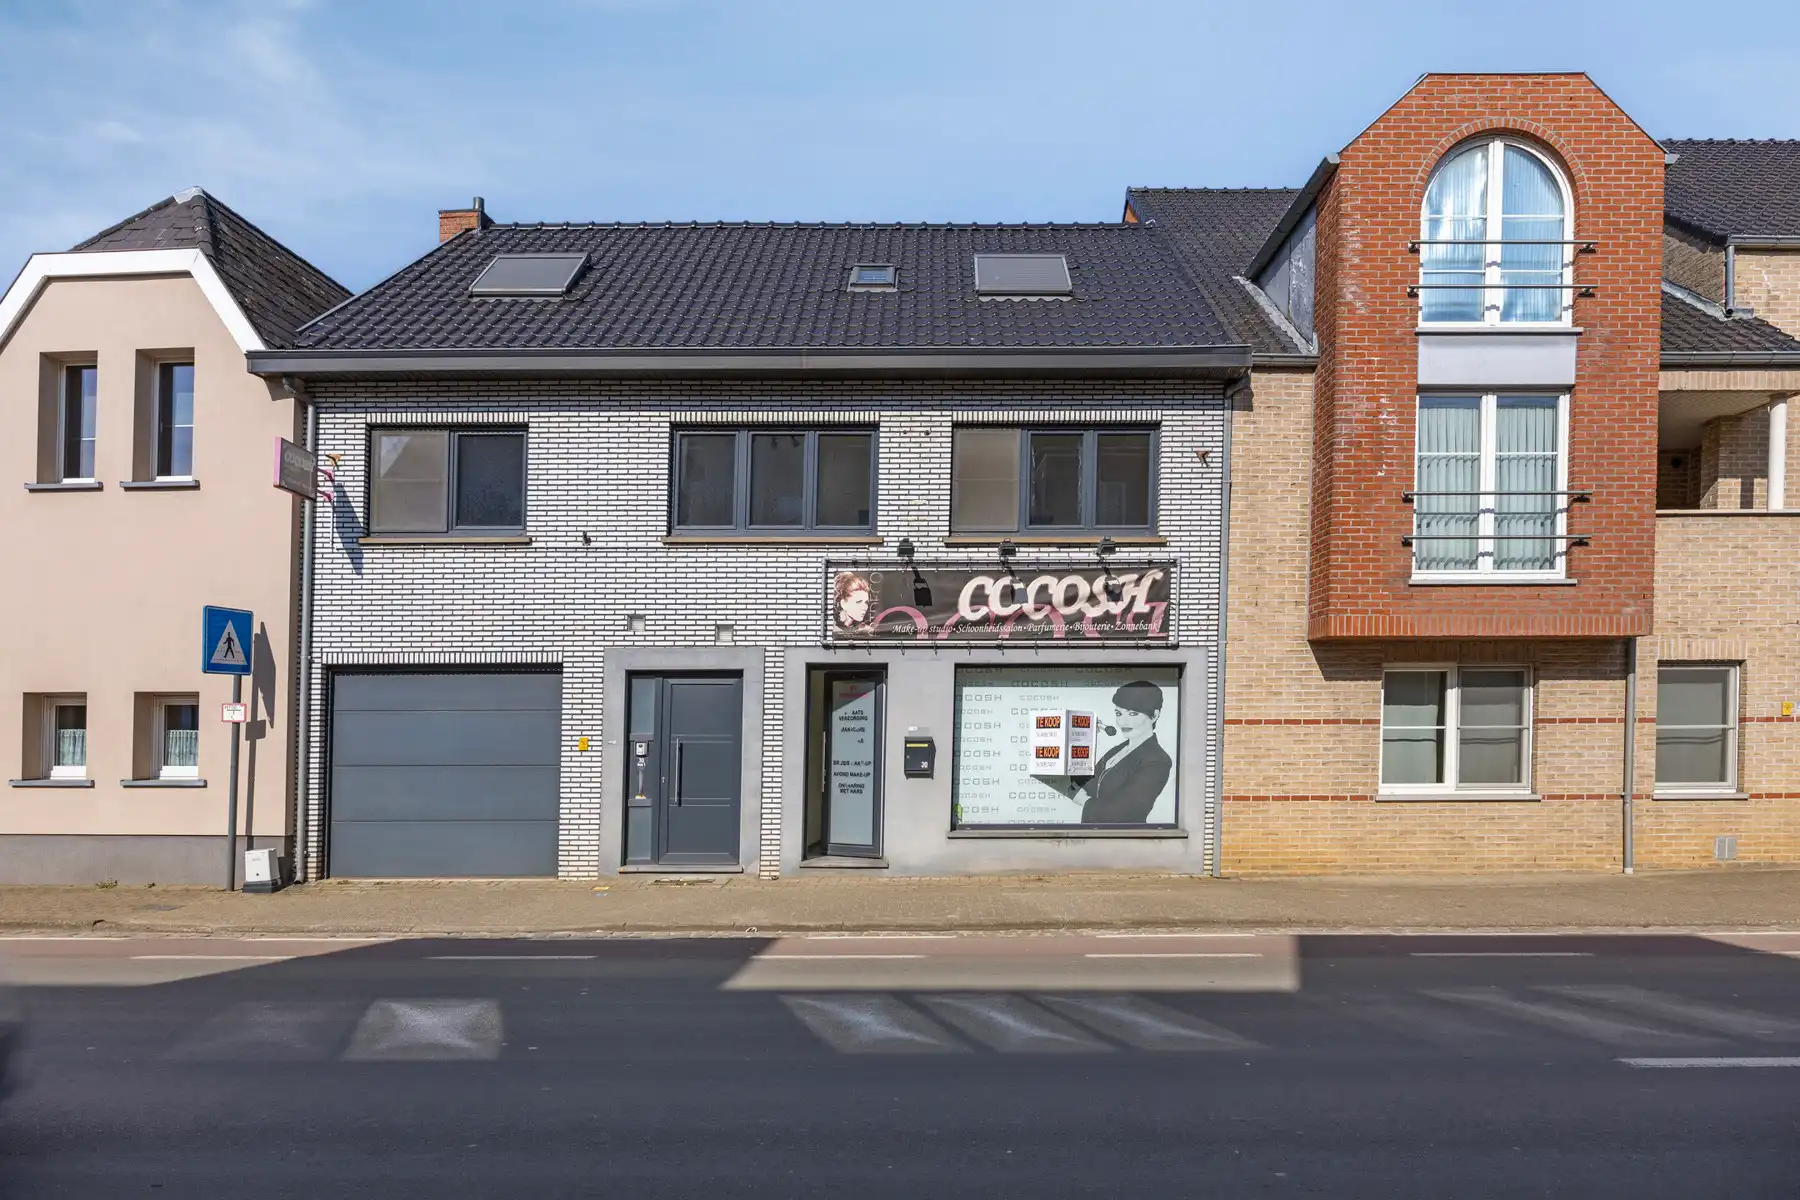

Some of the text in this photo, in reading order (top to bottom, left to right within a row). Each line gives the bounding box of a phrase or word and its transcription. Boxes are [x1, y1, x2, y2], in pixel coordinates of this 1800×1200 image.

[957, 569, 1164, 621] COCOSH
[892, 624, 928, 636] Make-up
[929, 622, 953, 633] studio
[956, 622, 1023, 633] Schoonheidssalon
[1026, 621, 1070, 635] Parfumerie
[1073, 620, 1111, 634] Bijouterie
[1036, 717, 1044, 728] TE
[1045, 716, 1061, 728] KOOP
[1078, 716, 1091, 728] KOOP
[1036, 747, 1043, 758] TE
[1044, 746, 1060, 758] KOOP
